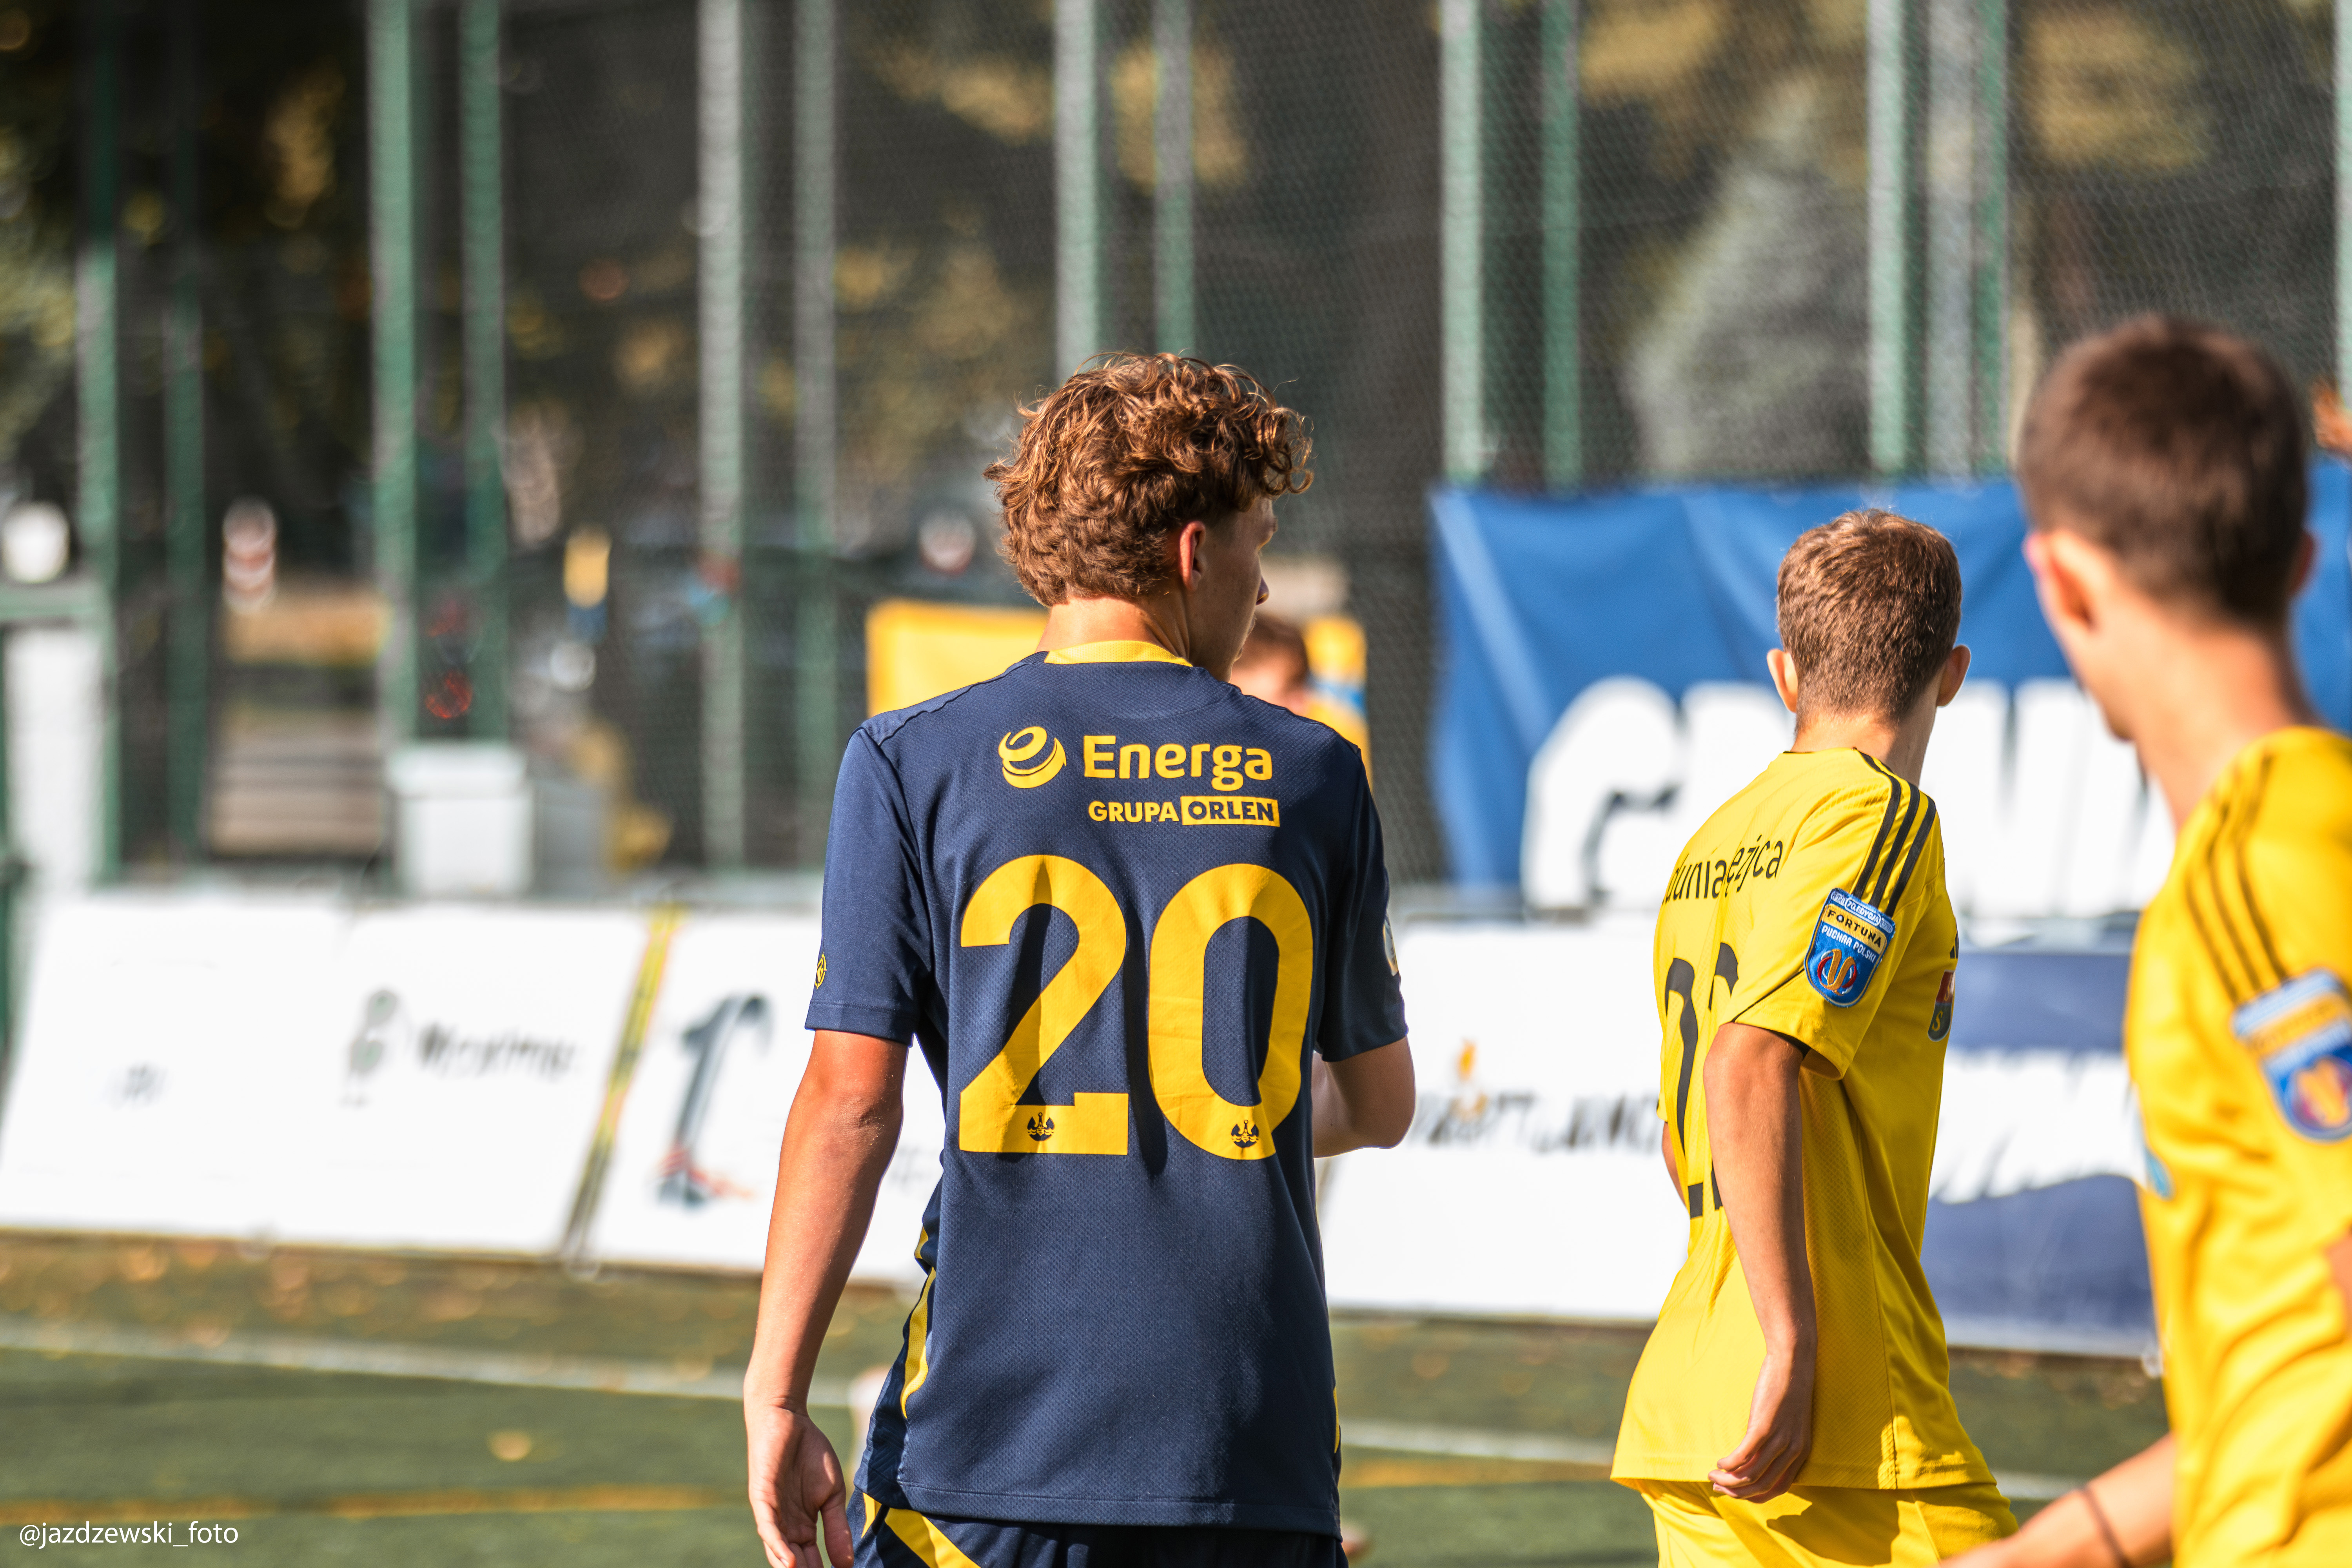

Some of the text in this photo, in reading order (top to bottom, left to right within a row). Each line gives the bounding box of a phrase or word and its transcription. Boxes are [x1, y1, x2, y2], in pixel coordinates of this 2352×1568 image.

[1083, 735, 1272, 791] Energa
[1088, 800, 1274, 822] GRUPA ORLEN
[1822, 926, 1876, 963] PUCHAR POLSKI
[1827, 909, 1881, 948] FORTUNA
[959, 854, 1313, 1160] 20
